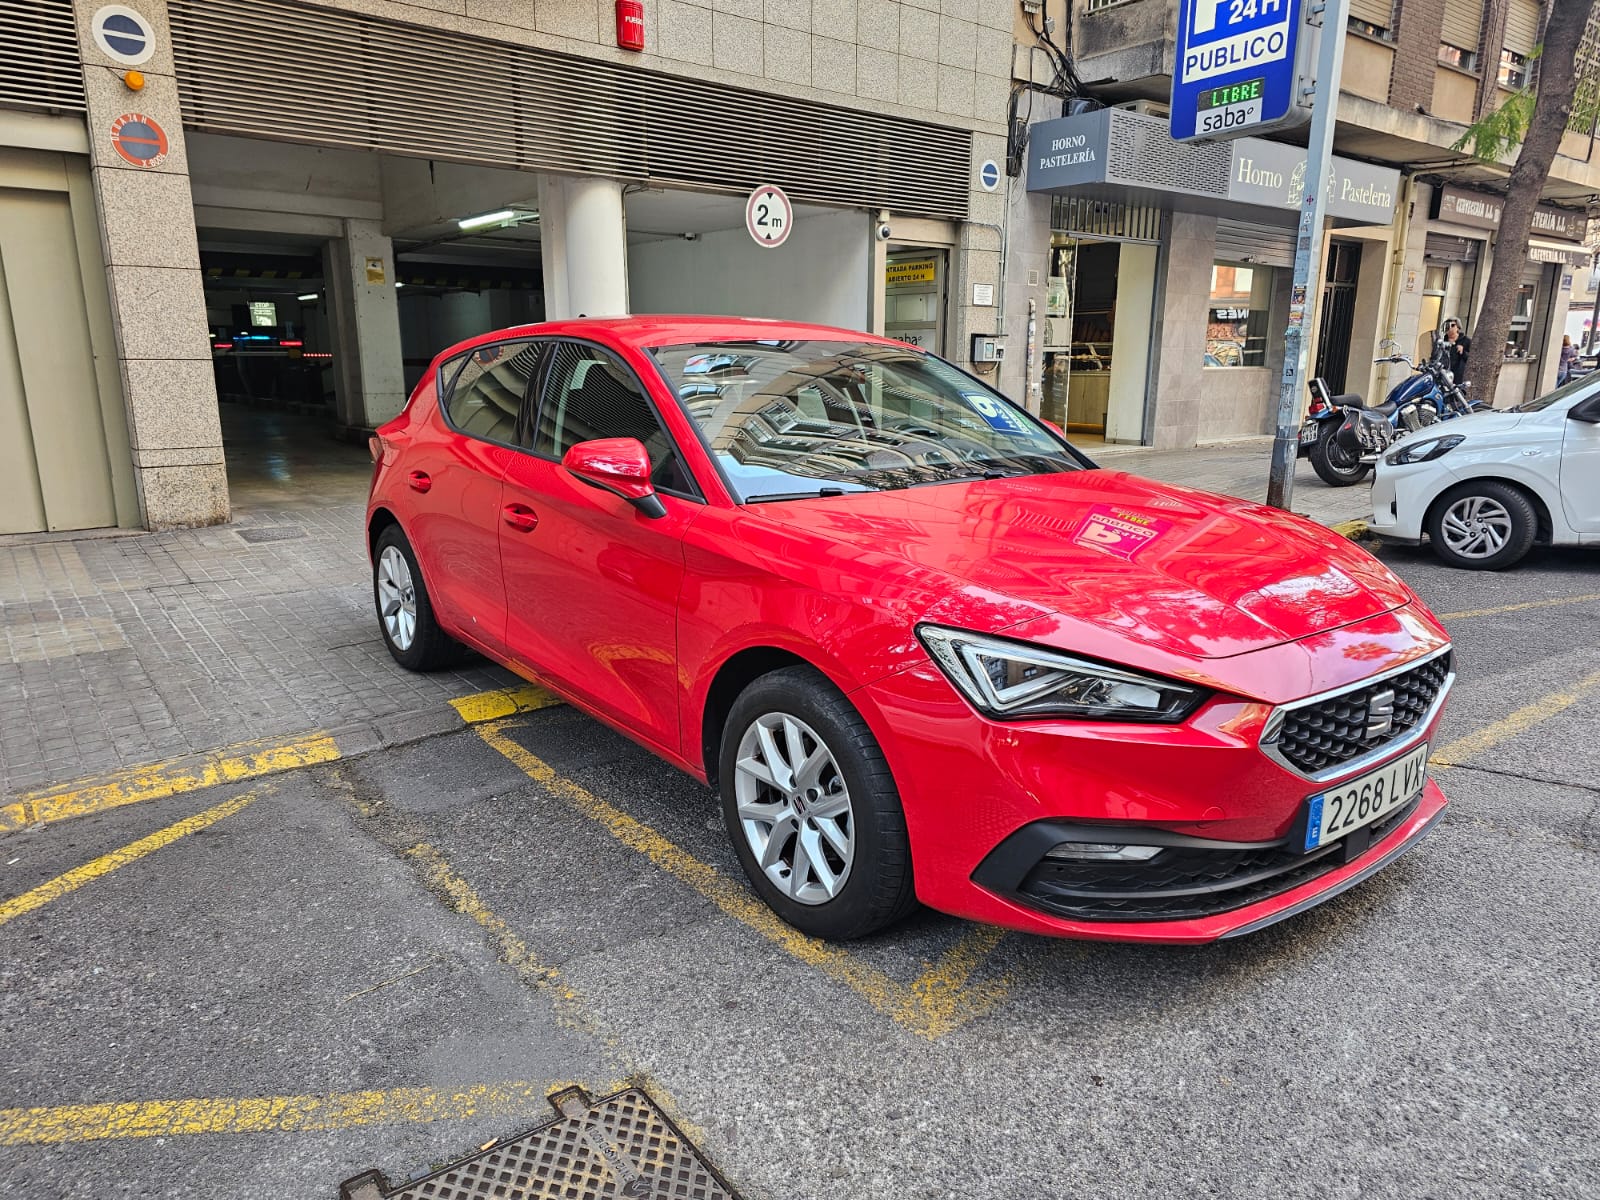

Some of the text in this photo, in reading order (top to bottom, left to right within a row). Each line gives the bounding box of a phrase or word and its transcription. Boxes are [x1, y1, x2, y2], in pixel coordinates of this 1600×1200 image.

[1185, 31, 1284, 76] PUBLICO
[1212, 81, 1260, 107] LIBRE
[1052, 134, 1086, 151] HORNO
[1040, 147, 1096, 170] PASTELERÍA
[1237, 157, 1282, 189] Horno
[757, 204, 782, 228] 2 m
[1327, 753, 1424, 835] 2268 LVX
